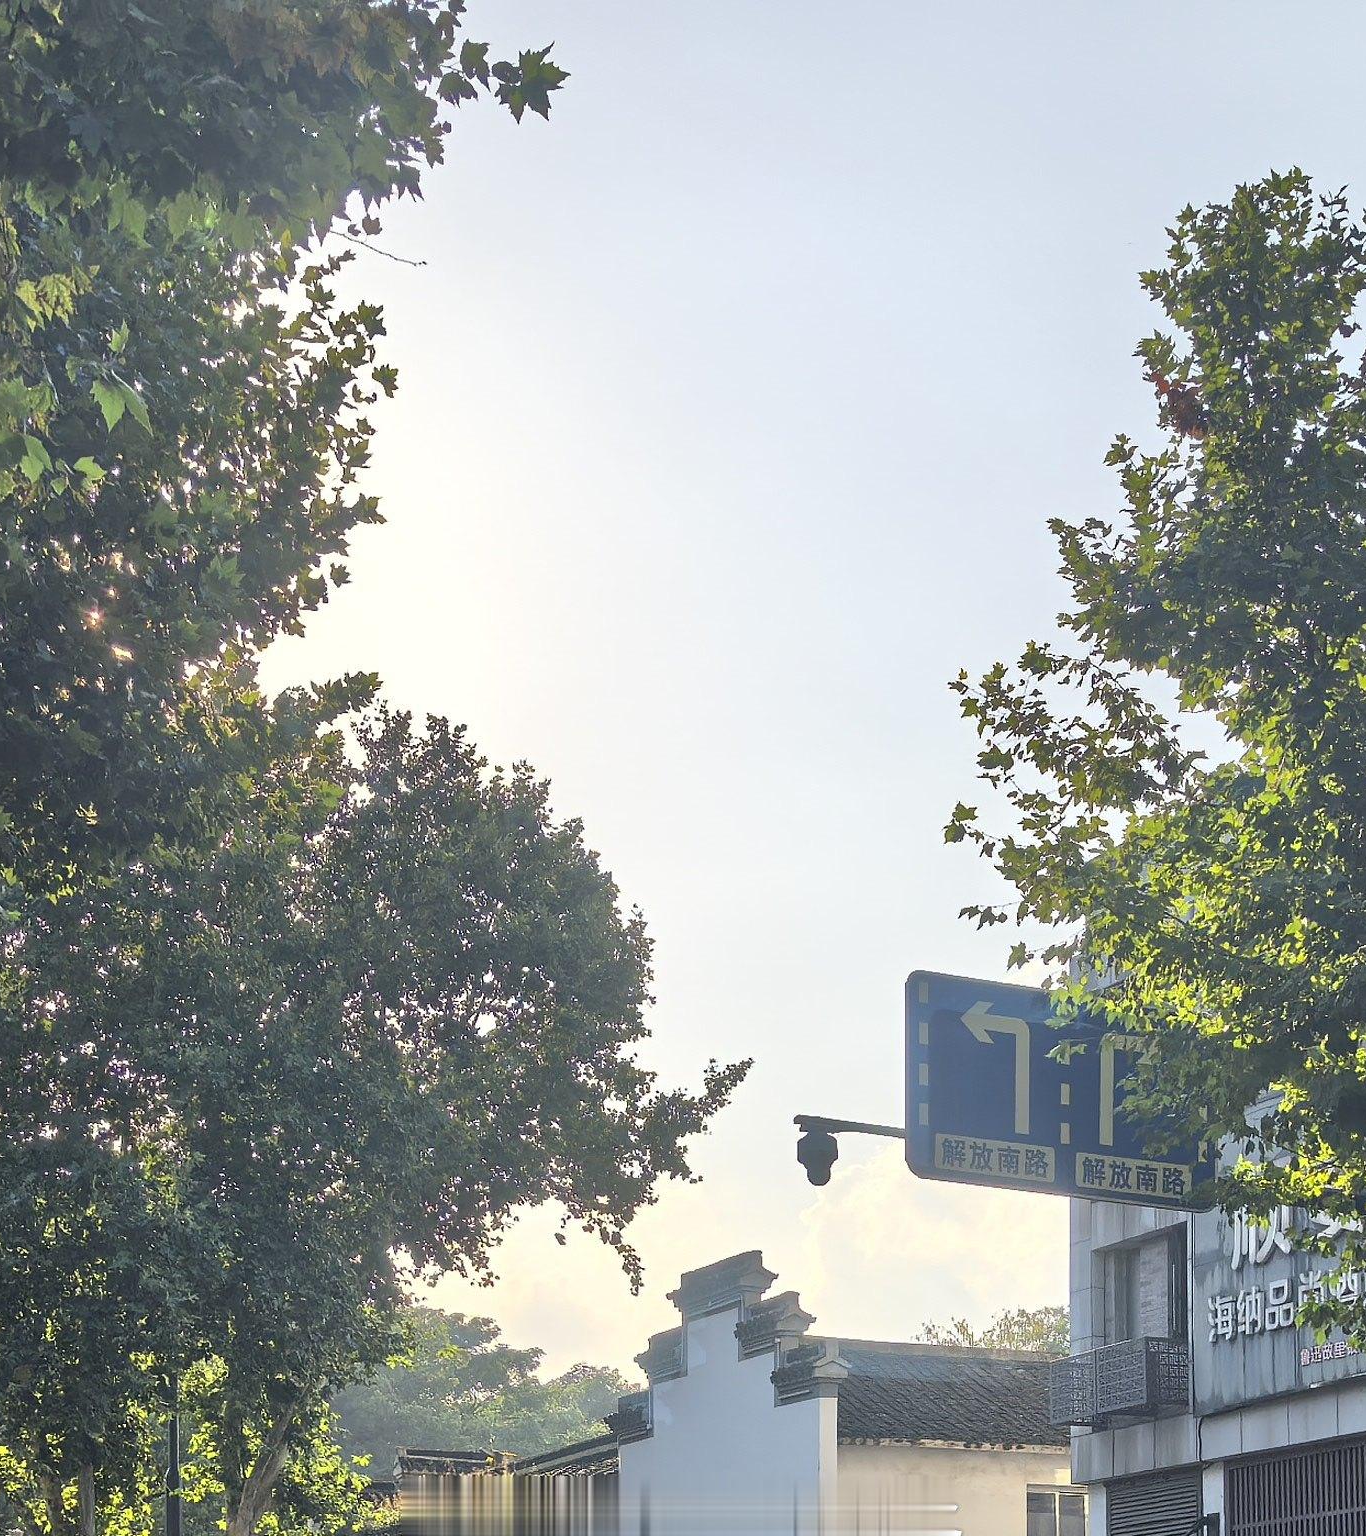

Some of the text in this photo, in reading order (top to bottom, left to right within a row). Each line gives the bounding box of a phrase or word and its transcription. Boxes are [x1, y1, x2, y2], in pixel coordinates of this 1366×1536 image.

[941, 1138, 1050, 1178] 解放南路
[1081, 1156, 1187, 1196] 解放南路
